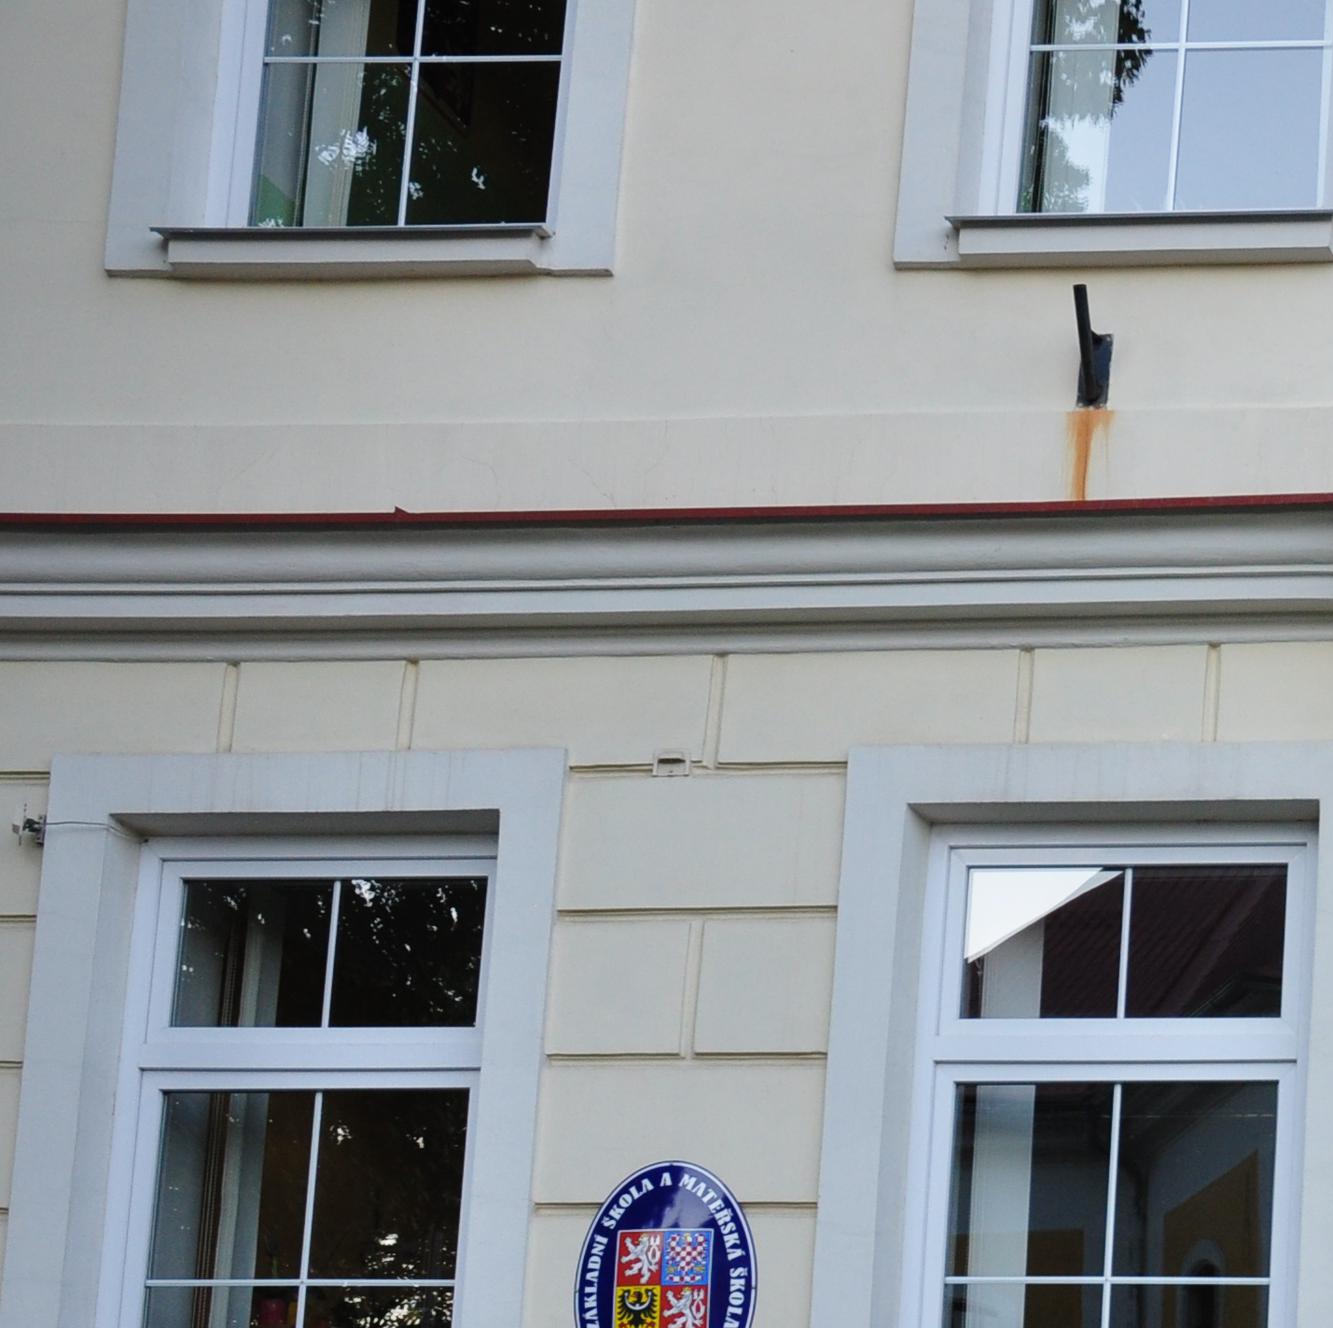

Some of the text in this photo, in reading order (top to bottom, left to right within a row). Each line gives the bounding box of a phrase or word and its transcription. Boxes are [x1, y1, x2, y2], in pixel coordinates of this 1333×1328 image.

[602, 1178, 654, 1230] ŠKOLA
[660, 1172, 672, 1186] A
[679, 1174, 742, 1261] MATEŘSKÁ
